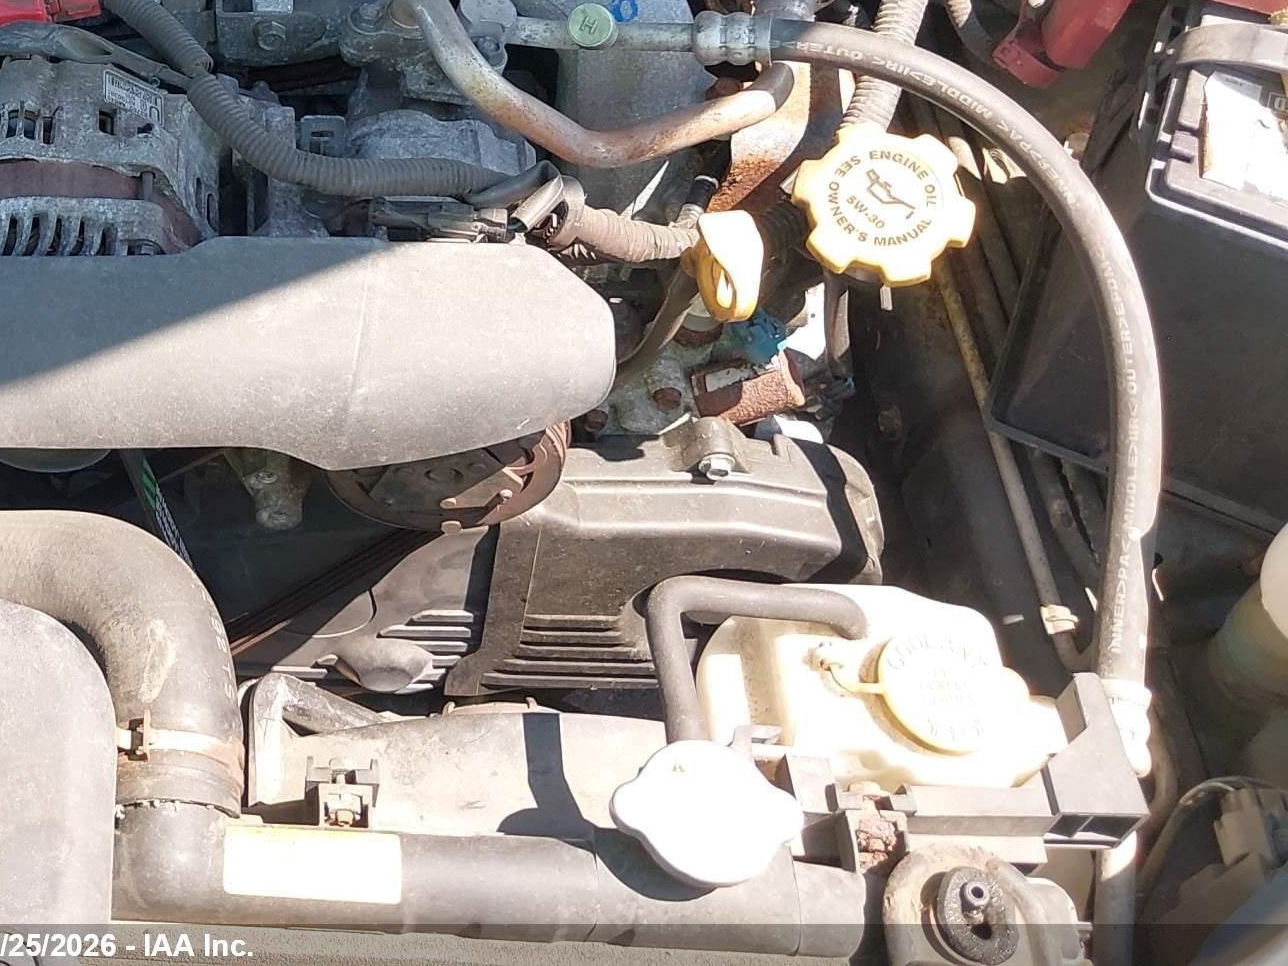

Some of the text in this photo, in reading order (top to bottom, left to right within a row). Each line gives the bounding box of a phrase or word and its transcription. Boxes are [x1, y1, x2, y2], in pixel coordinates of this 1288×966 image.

[828, 155, 932, 246] SEE OWNER'S MANUAL
[869, 150, 937, 207] ENGINE OIL
[846, 195, 885, 229] 5W-30
